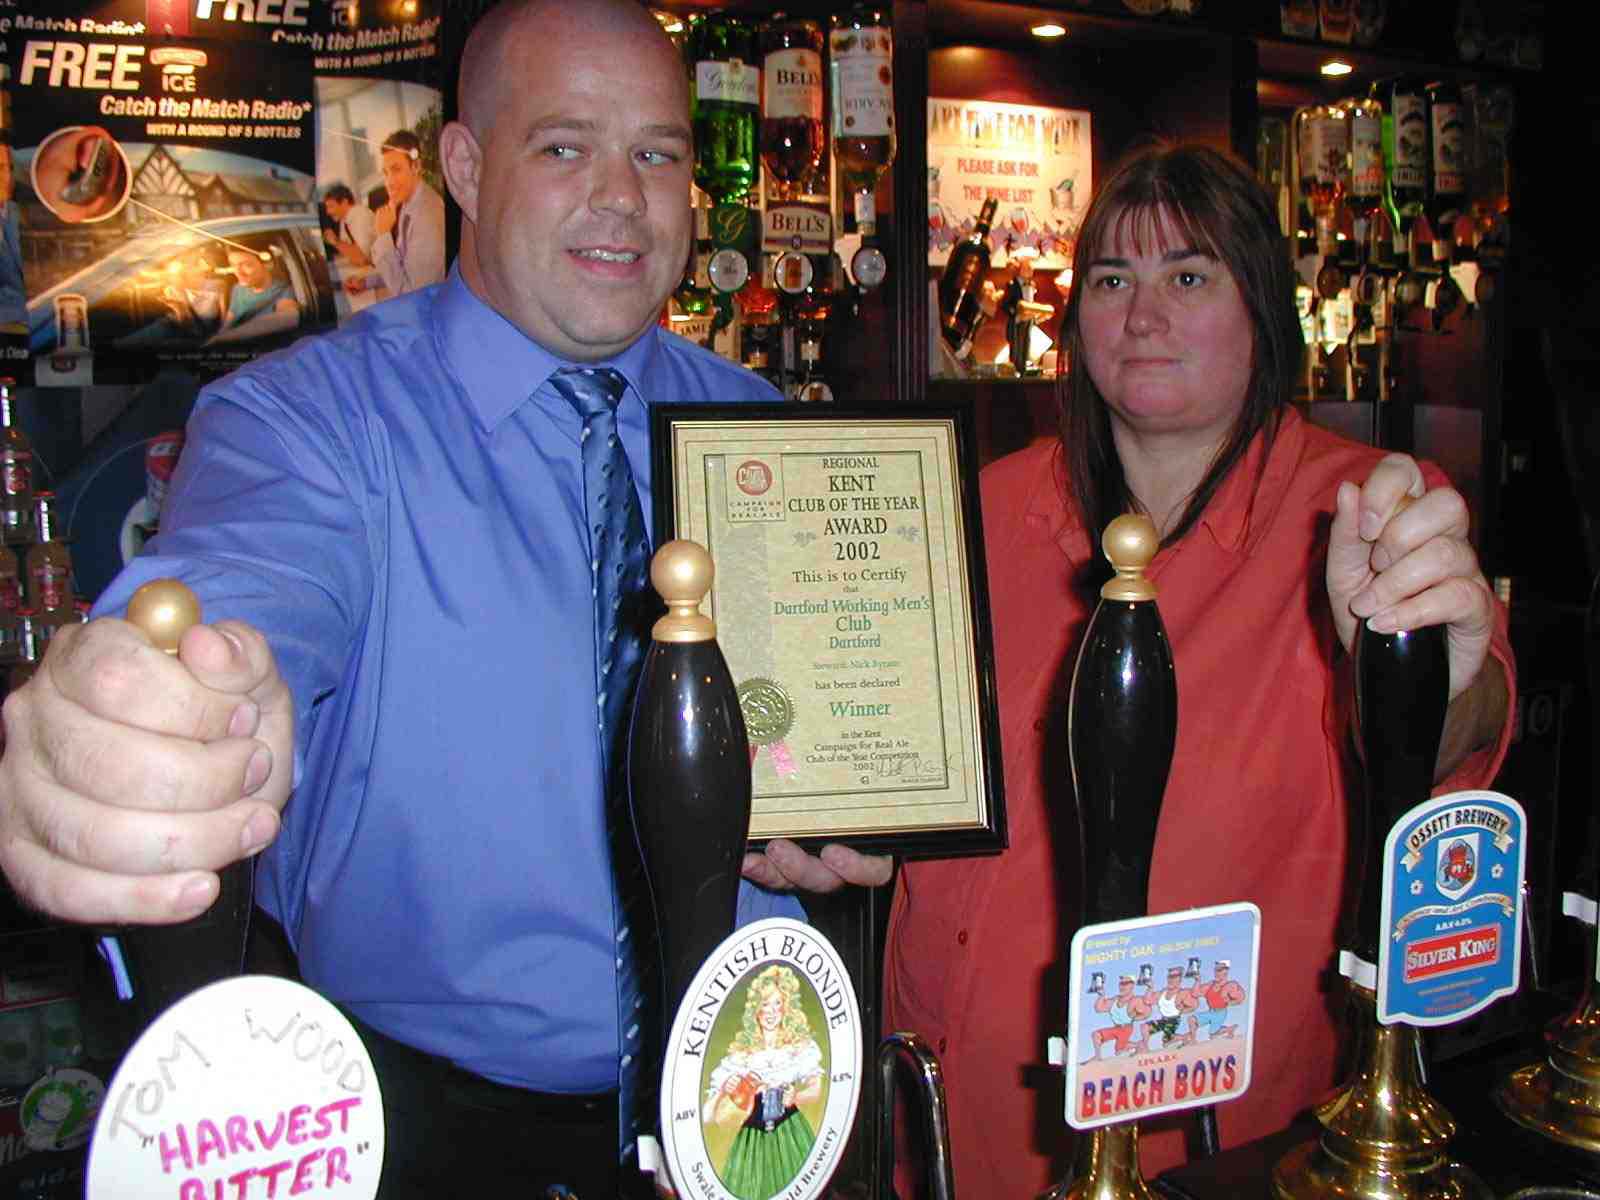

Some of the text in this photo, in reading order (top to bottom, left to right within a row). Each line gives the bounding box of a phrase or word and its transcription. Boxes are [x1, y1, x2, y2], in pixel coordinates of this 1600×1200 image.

[326, 32, 355, 50] the
[356, 26, 400, 48] Match
[19, 40, 146, 91] FREE
[161, 75, 197, 92] ICE
[100, 95, 156, 116] Catch
[158, 97, 191, 117] the
[191, 98, 250, 119] Match
[146, 123, 176, 136] WITH
[177, 125, 187, 136] A
[188, 124, 226, 137] ROUND
[227, 126, 242, 137] OF
[254, 126, 301, 139] BOTTLES
[957, 157, 1039, 177] PLEASE ASK FOR
[963, 185, 981, 201] THE
[1013, 189, 1033, 203] LIST
[771, 211, 824, 233] BELL'S
[823, 457, 880, 469] REGIONAL
[829, 475, 875, 492] KENT
[788, 496, 920, 512] CLUB OF THE YEAR
[824, 518, 888, 536] AWARD
[834, 541, 881, 561] 2002
[792, 567, 907, 584] This is to Certify
[774, 595, 930, 616] Dartford Working Men's
[836, 614, 872, 632] Club
[830, 634, 881, 649] Dartford
[815, 677, 901, 690] has been declared
[829, 700, 892, 717] Winner
[851, 729, 862, 738] the
[814, 738, 910, 752] Campaign for Real Ale
[806, 754, 826, 763] Club
[827, 753, 836, 762] of
[837, 753, 850, 762] the
[1411, 809, 1508, 849] OSSETT BREWERY
[1407, 937, 1497, 970] SILVER KING
[684, 935, 849, 1058] KENTISH BLONDE
[110, 1007, 366, 1140] TOM WOOD
[1081, 1054, 1237, 1118] BEACH BOYS
[675, 1109, 697, 1122] ABV
[692, 1161, 716, 1200] Swale
[800, 1127, 838, 1187] Brewery
